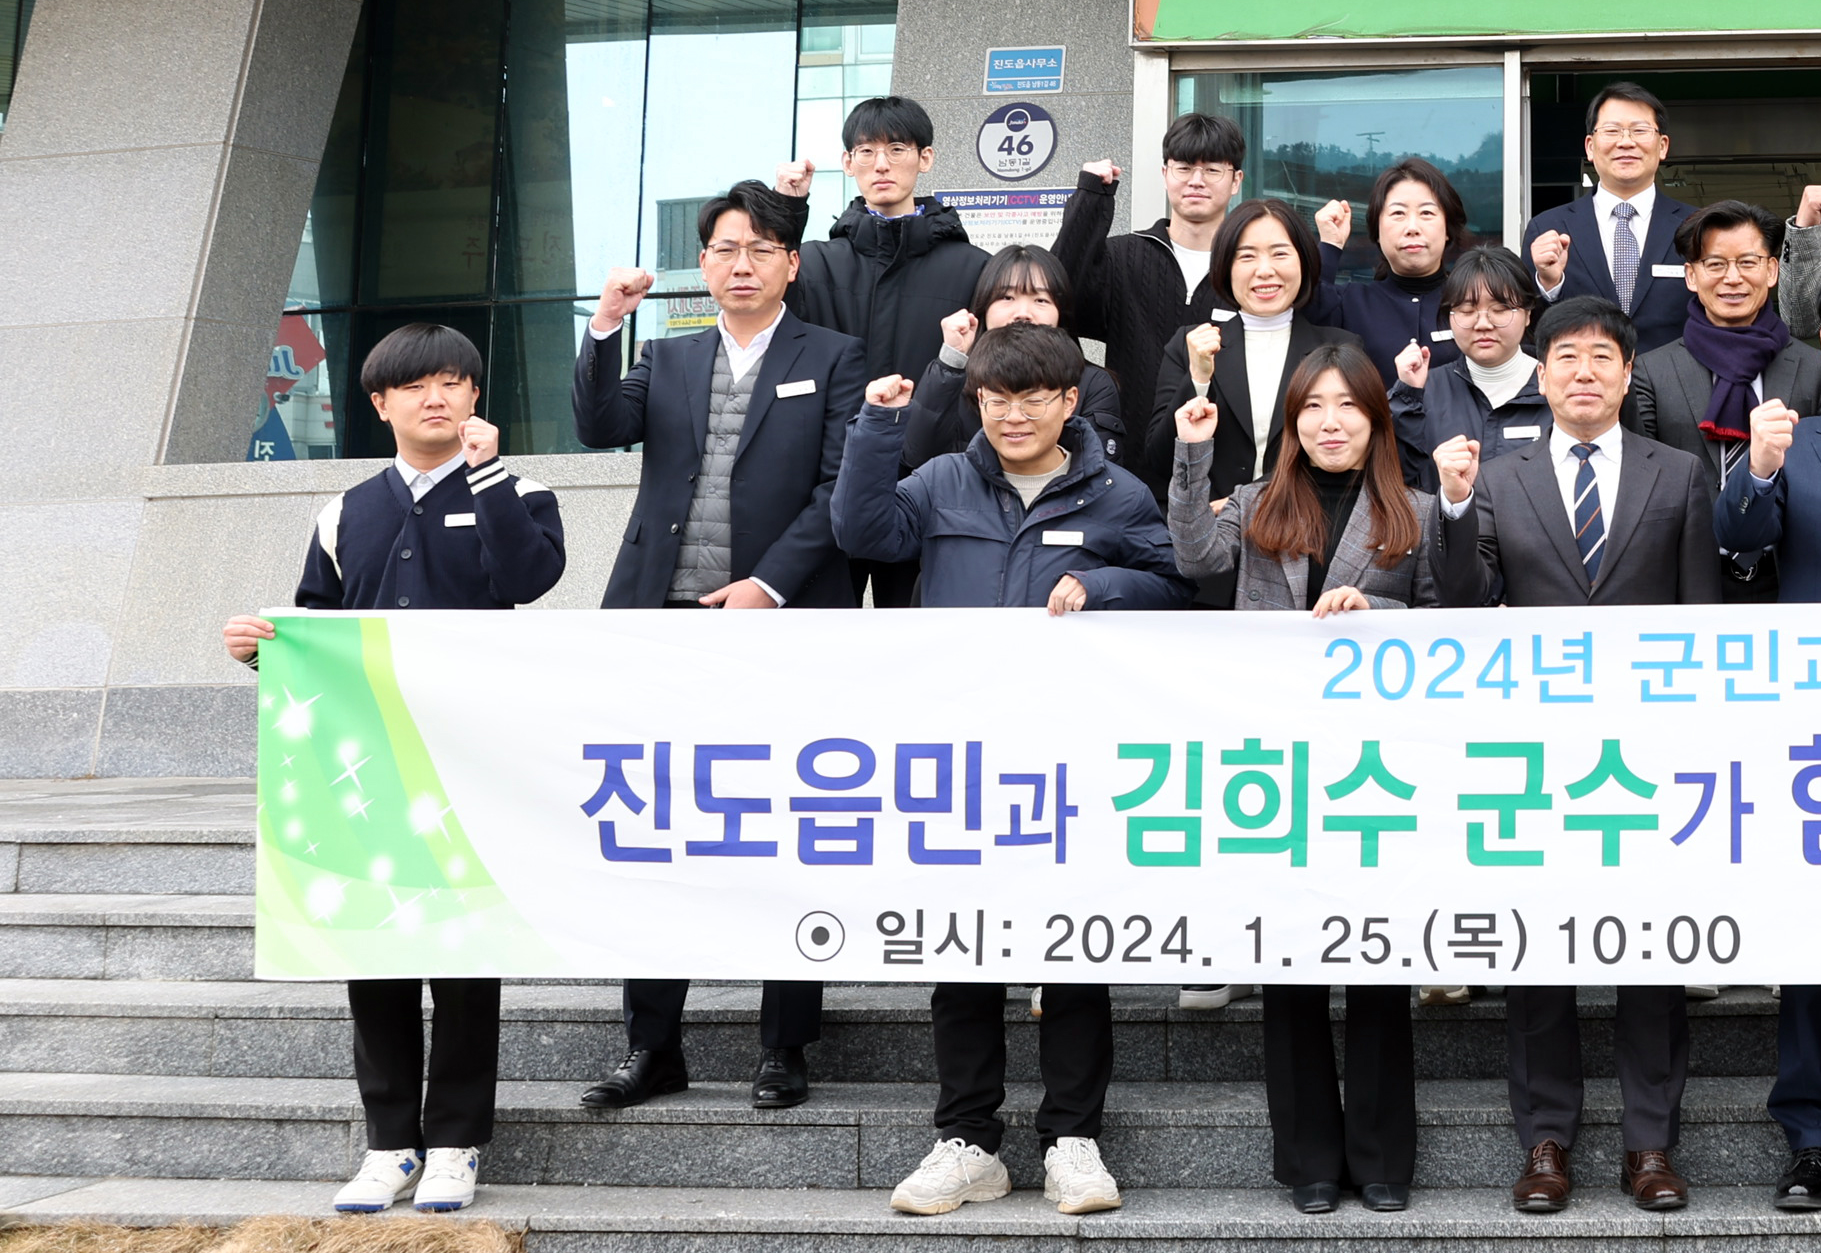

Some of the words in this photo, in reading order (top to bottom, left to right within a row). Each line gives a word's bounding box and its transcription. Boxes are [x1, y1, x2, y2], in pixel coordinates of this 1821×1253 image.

[993, 58, 1058, 70] 진도읍사무소
[997, 135, 1034, 156] 46
[1324, 632, 1593, 702] 2024년
[582, 739, 1077, 864] 진도읍민과
[1113, 739, 1416, 867] 김희수
[1459, 740, 1753, 866] 군수가
[877, 910, 1011, 965] 일시:
[1045, 915, 1211, 966] 2024.
[1246, 917, 1291, 966] 1.
[1321, 909, 1526, 971] 25.(목)
[1559, 916, 1740, 964] 10:00
